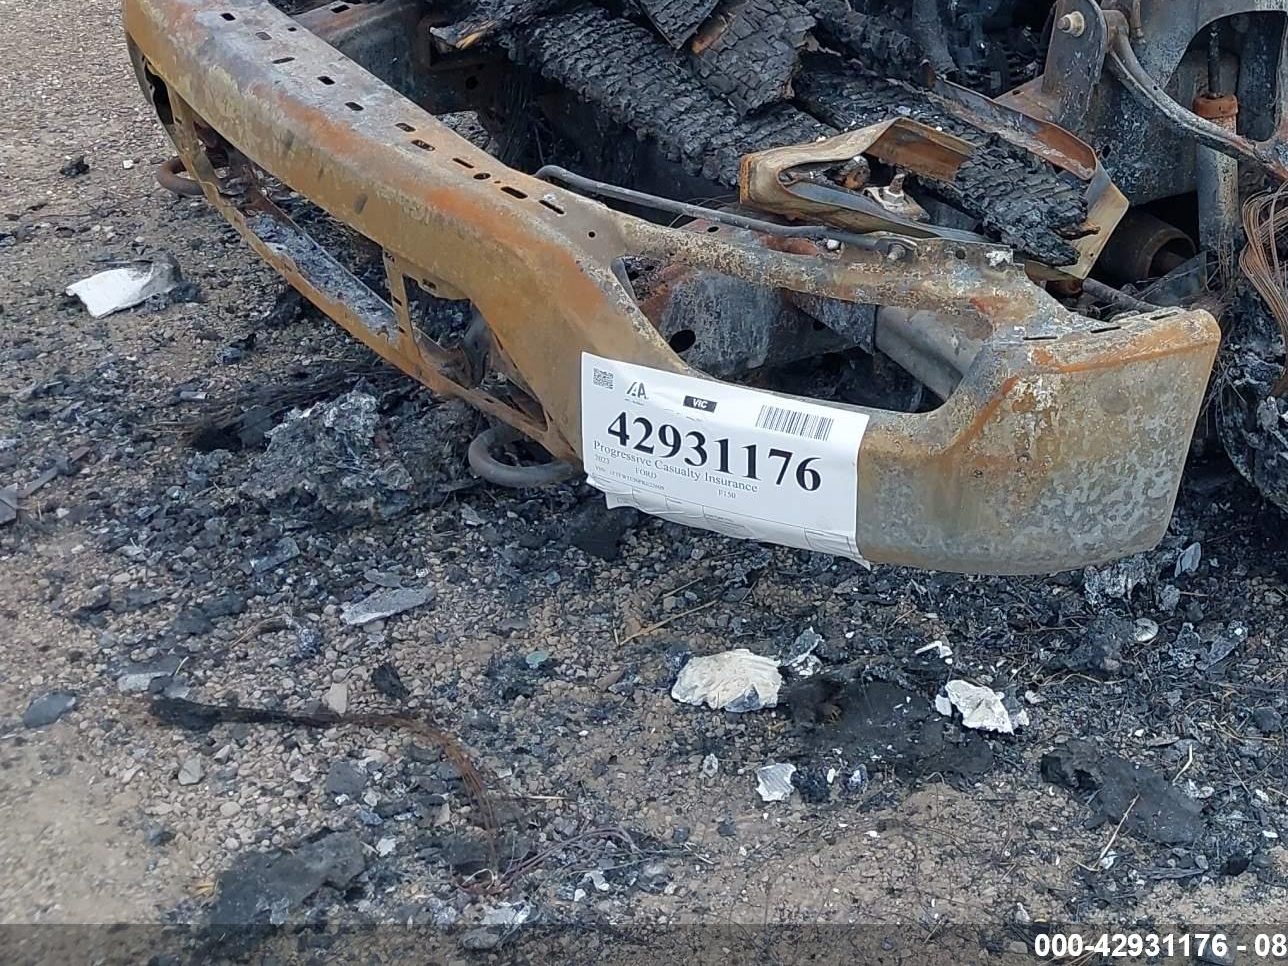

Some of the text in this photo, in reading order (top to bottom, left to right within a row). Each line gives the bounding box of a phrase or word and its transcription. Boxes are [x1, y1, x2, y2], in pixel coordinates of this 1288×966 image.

[692, 398, 708, 409] VIC
[607, 411, 822, 492] 42931176
[593, 440, 652, 467] Progressive
[654, 459, 701, 481] Casualty
[705, 472, 759, 493] Insurance
[635, 466, 657, 479] FORD
[717, 489, 737, 499] F150
